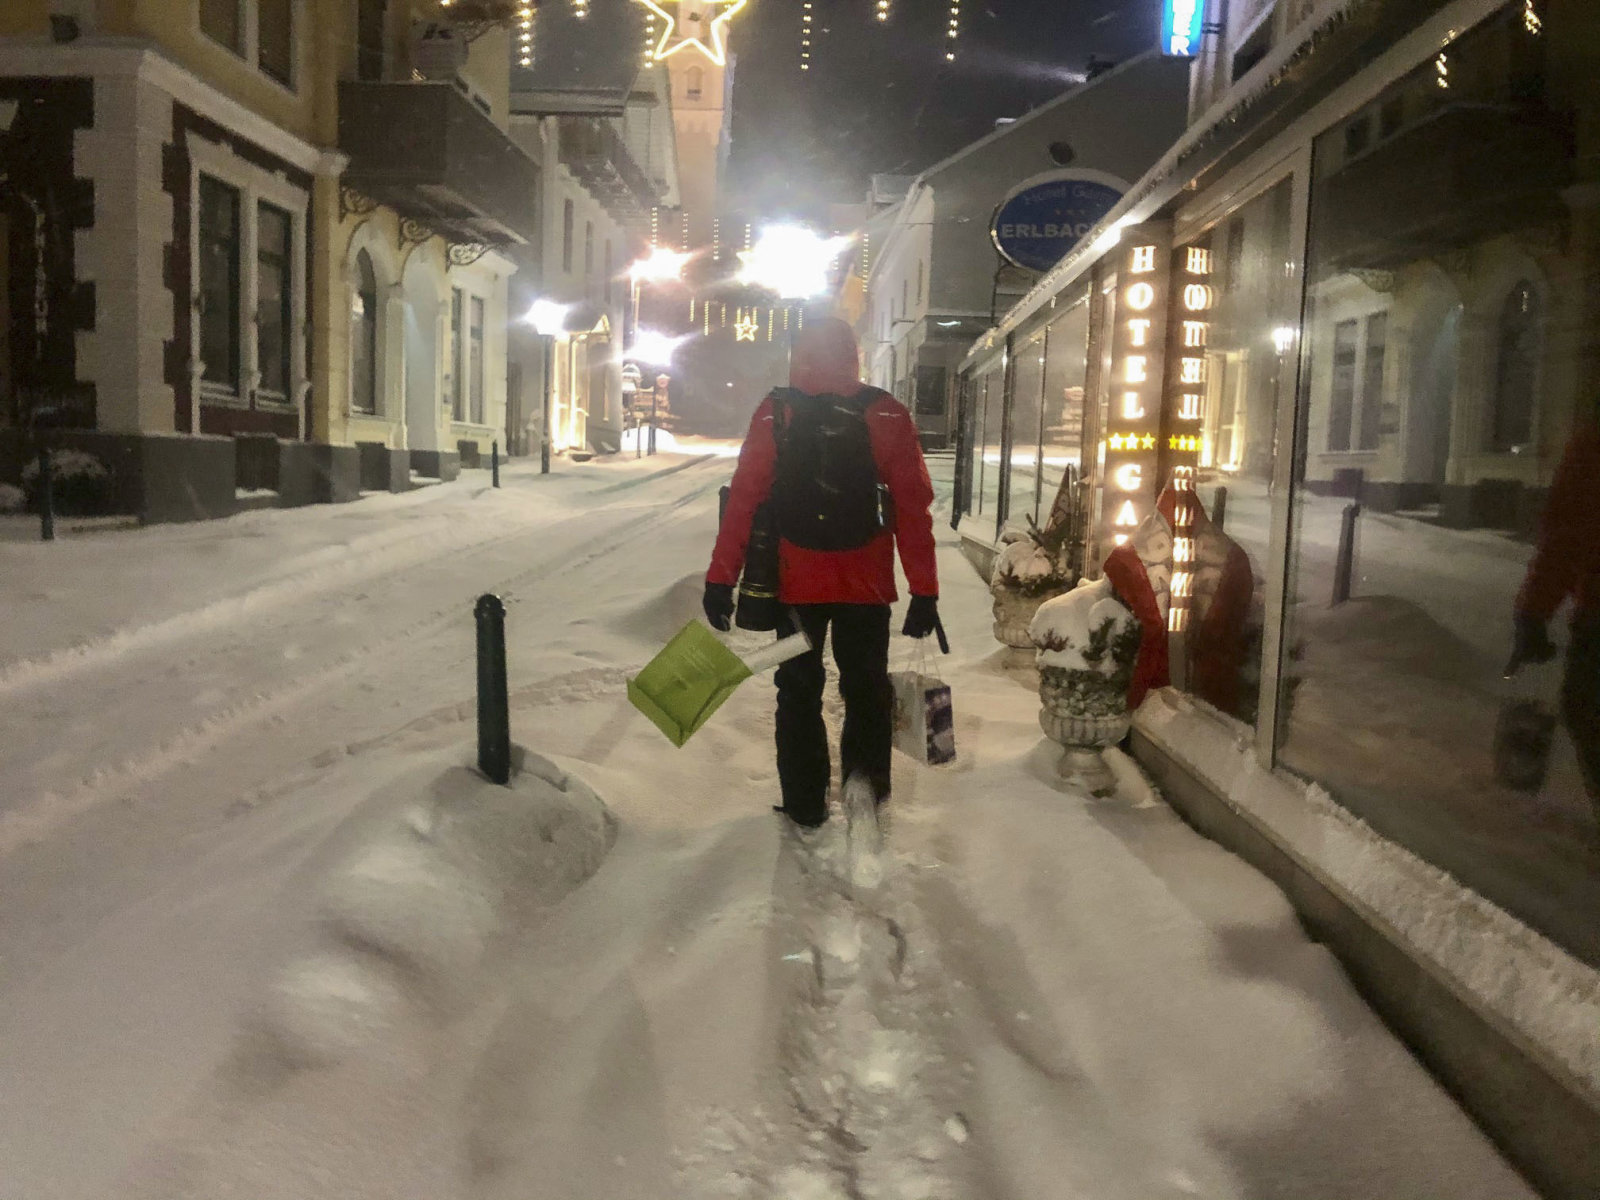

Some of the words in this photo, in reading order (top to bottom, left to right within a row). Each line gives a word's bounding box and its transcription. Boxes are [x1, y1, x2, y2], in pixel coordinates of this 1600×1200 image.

[1001, 223, 1094, 239] ERLBAC
[1122, 245, 1157, 420] HOTEL
[1113, 463, 1142, 546] GA
